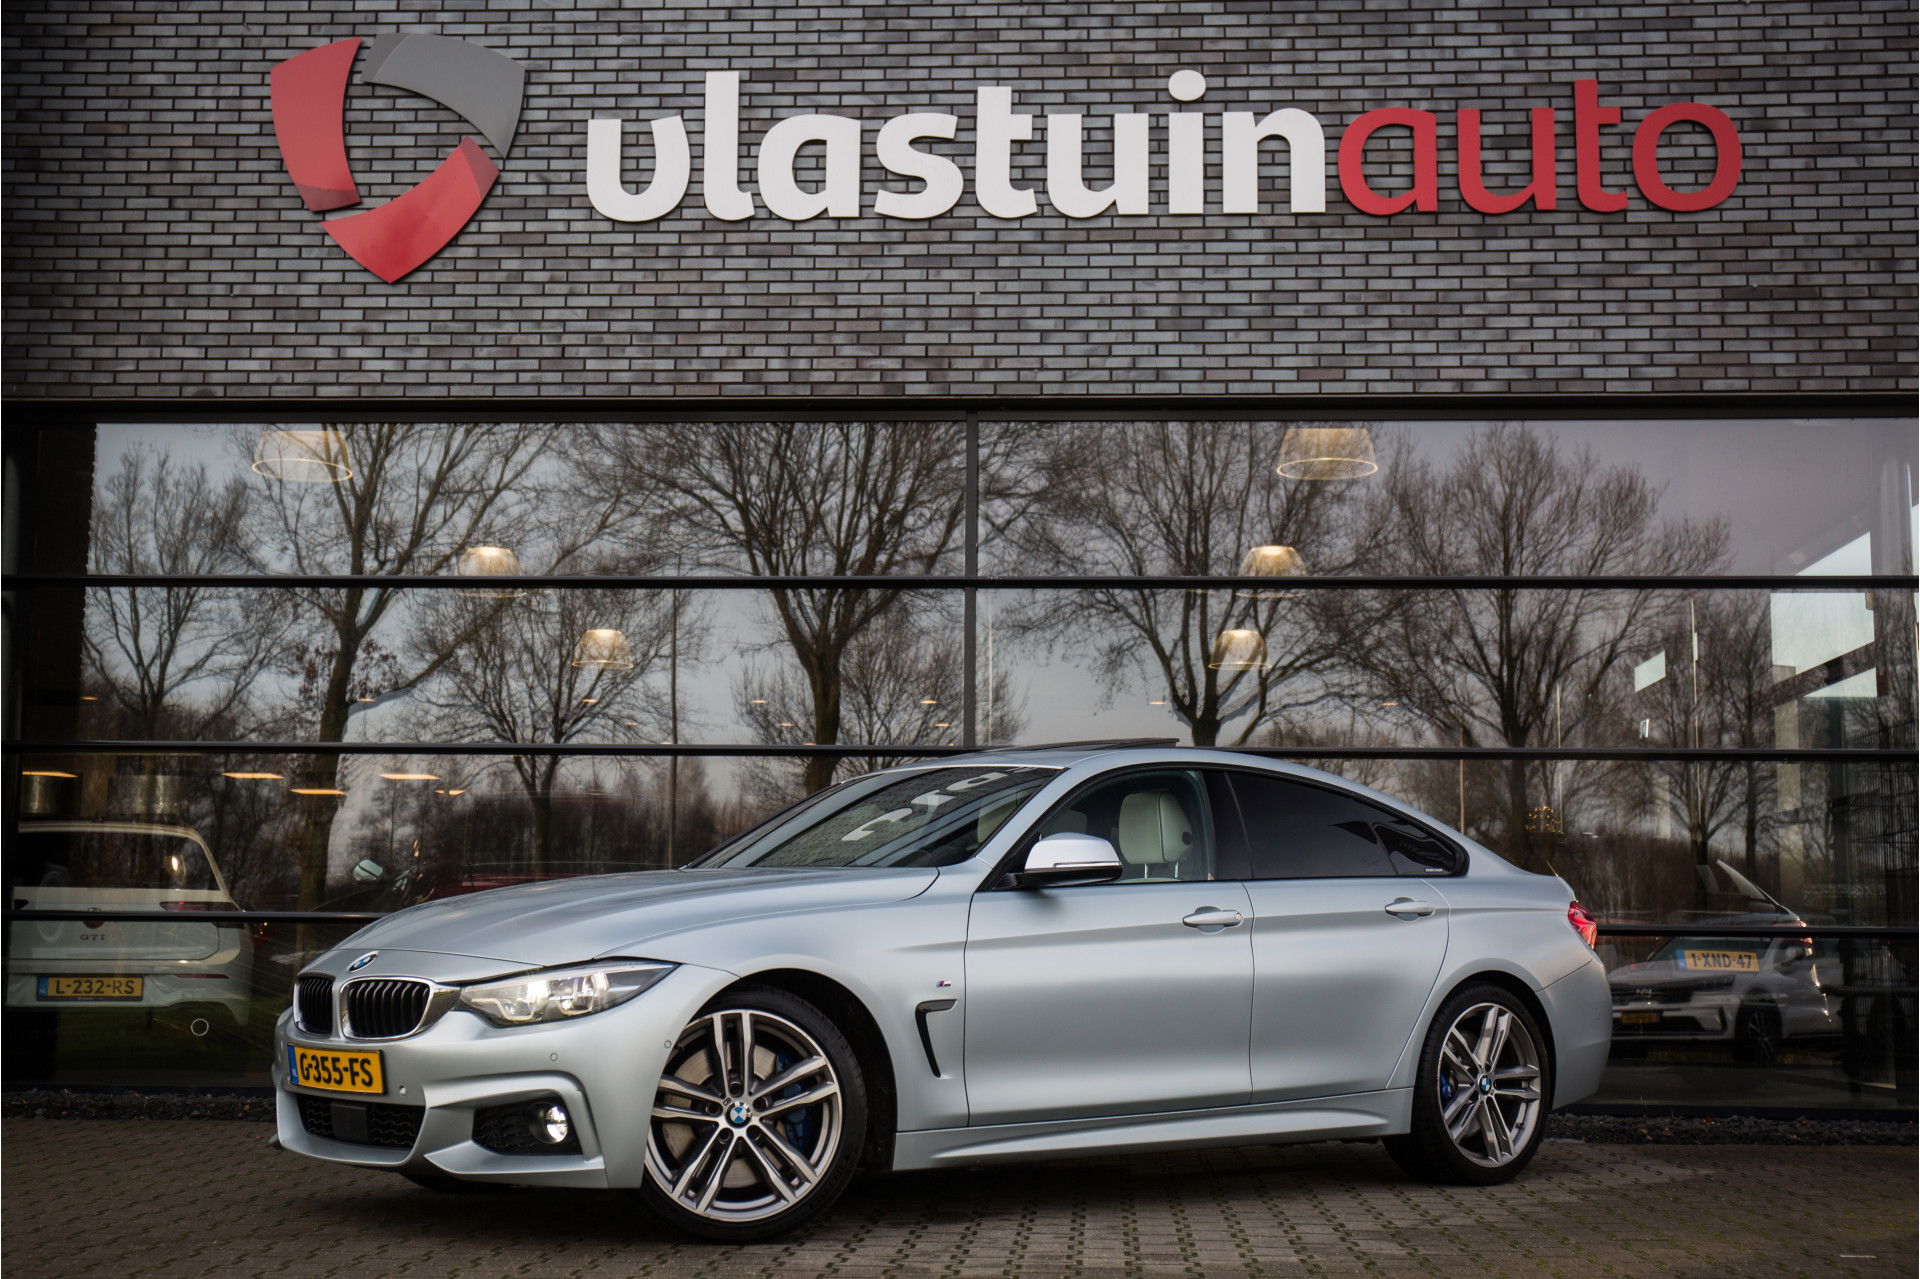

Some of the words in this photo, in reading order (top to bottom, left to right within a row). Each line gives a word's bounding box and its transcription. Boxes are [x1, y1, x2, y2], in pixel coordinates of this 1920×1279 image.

[1690, 953, 1752, 968] 1-XND-47
[55, 980, 135, 994] L-232-RS
[300, 1052, 374, 1087] G-355-FS
